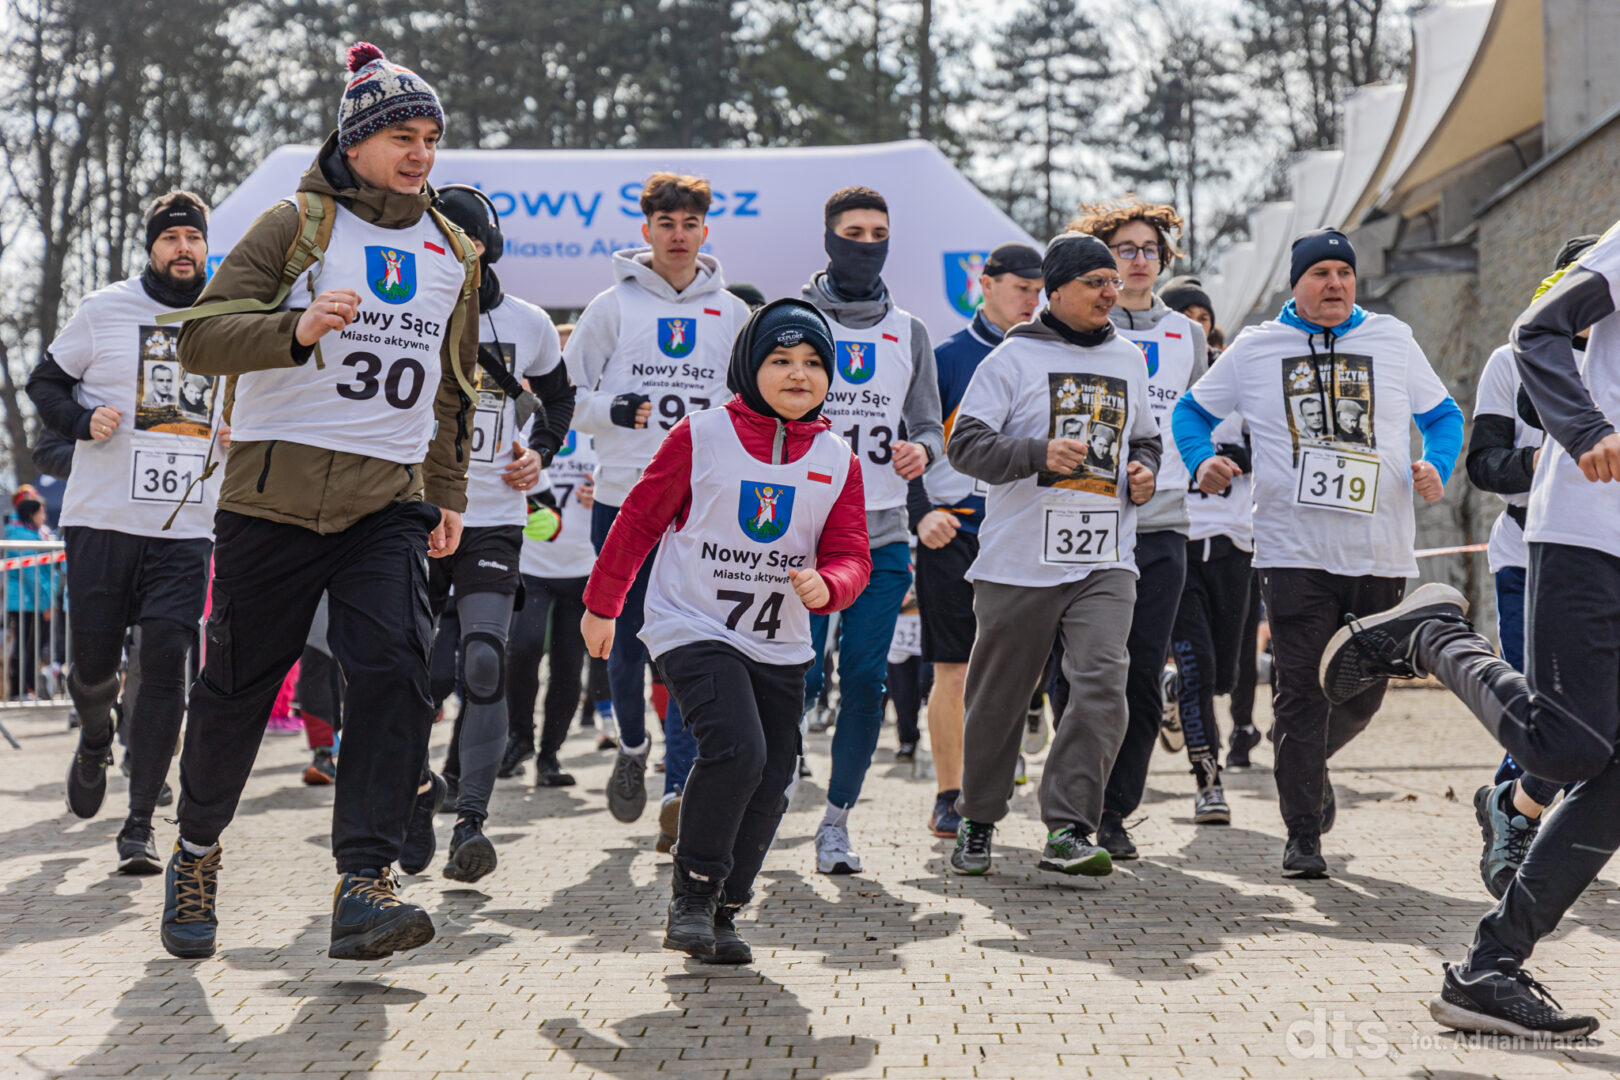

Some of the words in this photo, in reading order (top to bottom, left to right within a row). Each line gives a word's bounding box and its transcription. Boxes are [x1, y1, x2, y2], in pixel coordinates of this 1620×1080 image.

[473, 182, 603, 227] owy
[618, 182, 760, 217] Scz
[504, 237, 581, 258] iasto
[352, 311, 394, 331] owy
[400, 312, 440, 337] Sącz
[340, 331, 381, 344] Miasto
[384, 336, 430, 352] aktywne
[336, 351, 426, 410] 30
[632, 364, 678, 378] Nowy
[682, 364, 715, 380] Sącz
[825, 391, 857, 405] owy
[1148, 385, 1178, 402] Sącz
[143, 468, 192, 494] 361
[1310, 471, 1367, 502] 319
[1056, 528, 1109, 555] 327
[701, 542, 762, 570] Nowy
[766, 550, 806, 572] Sącz
[713, 569, 752, 582] Miasto
[717, 589, 785, 640] 74
